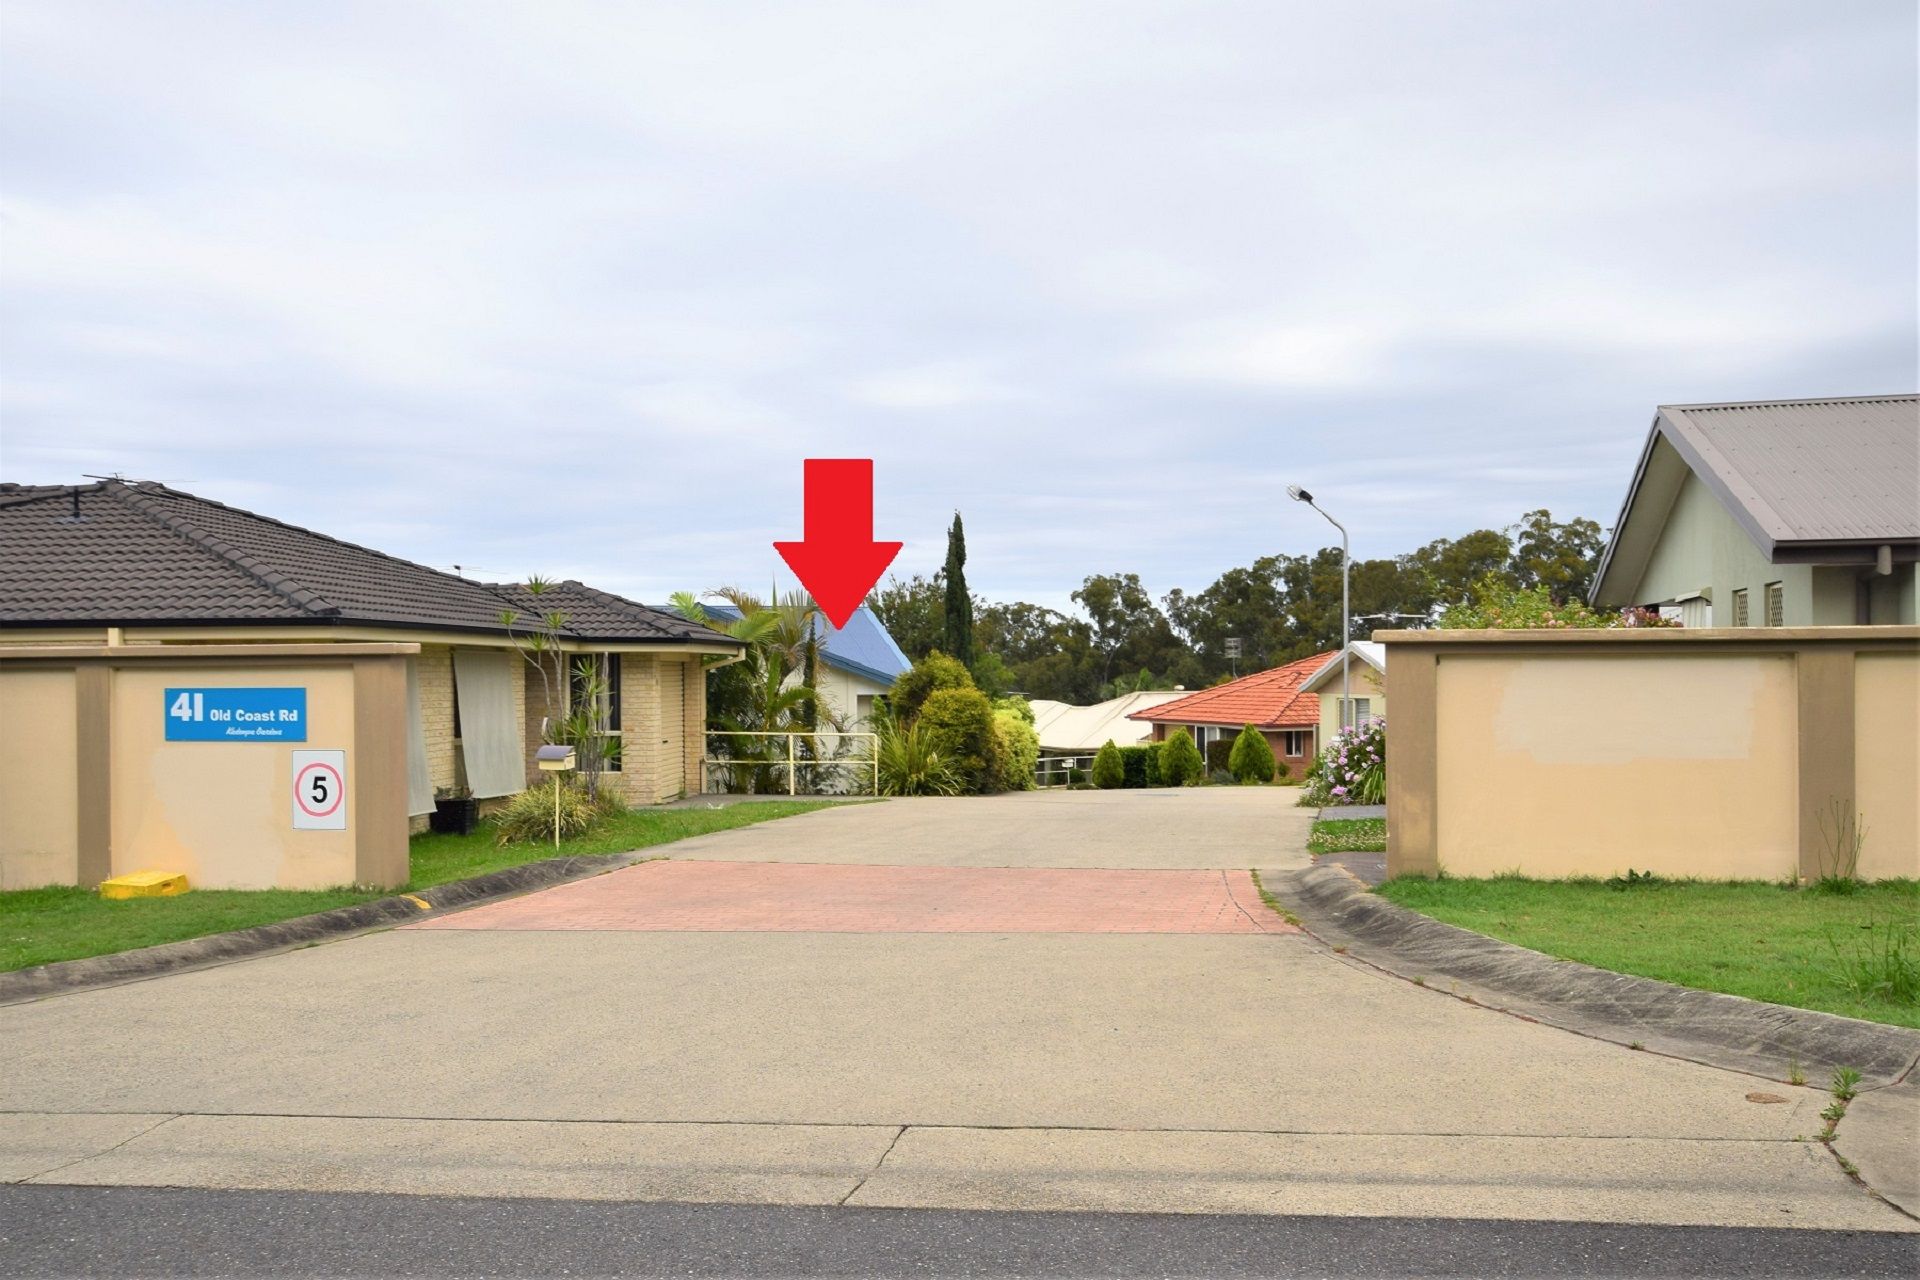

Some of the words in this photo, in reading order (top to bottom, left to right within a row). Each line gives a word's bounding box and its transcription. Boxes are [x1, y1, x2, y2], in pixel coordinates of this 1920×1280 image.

[170, 692, 203, 721] 41
[209, 709, 231, 721] Old
[235, 709, 275, 721] Coast
[278, 709, 298, 721] Rd
[311, 776, 328, 804] 5
